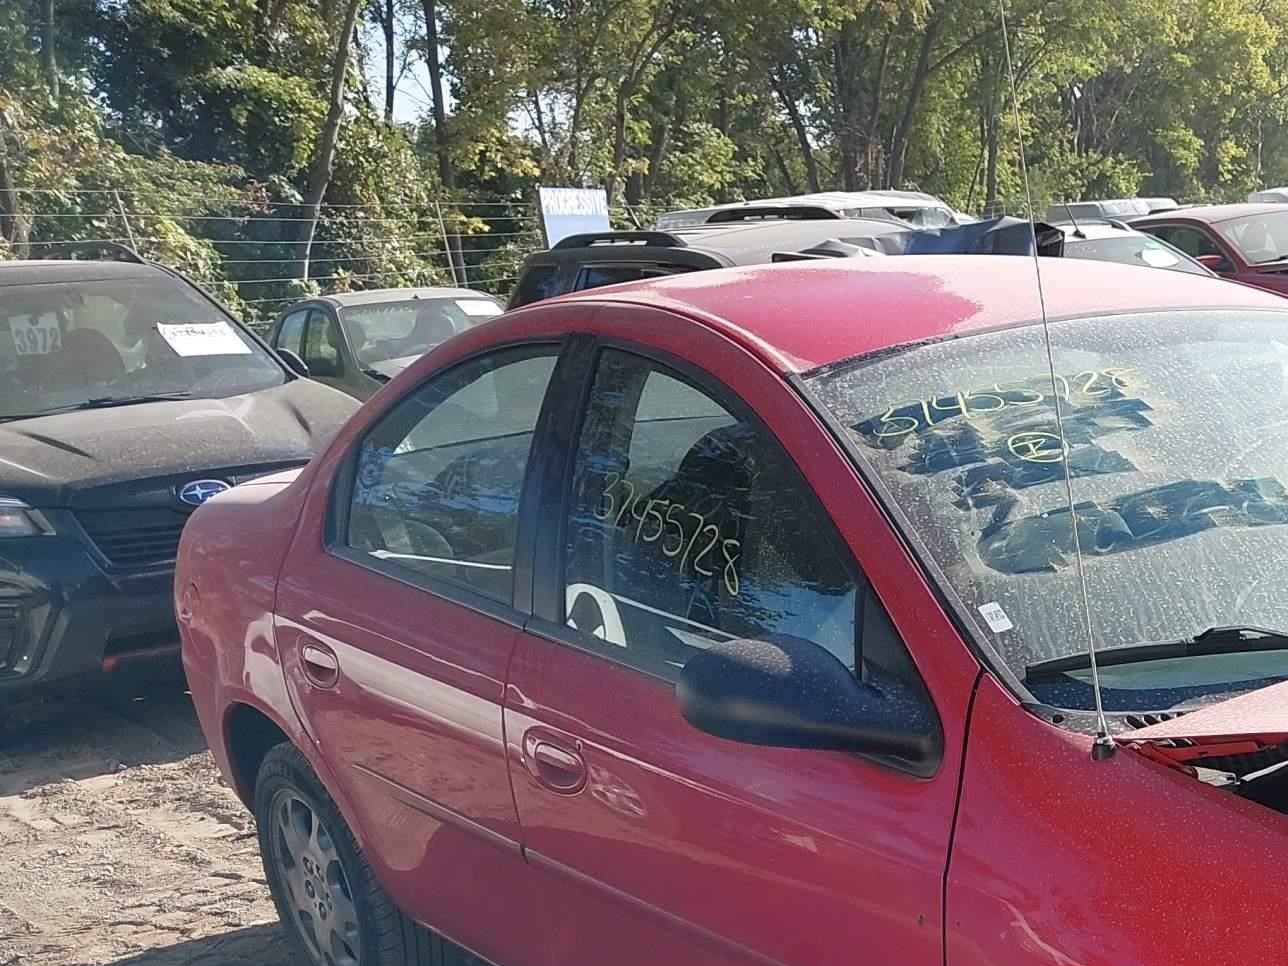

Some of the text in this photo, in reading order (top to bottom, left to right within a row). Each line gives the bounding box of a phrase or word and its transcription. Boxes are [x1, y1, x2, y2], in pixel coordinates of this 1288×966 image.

[541, 189, 609, 215] PROGRESSIVE
[14, 326, 61, 353] 3972
[593, 472, 741, 596] 37455728
